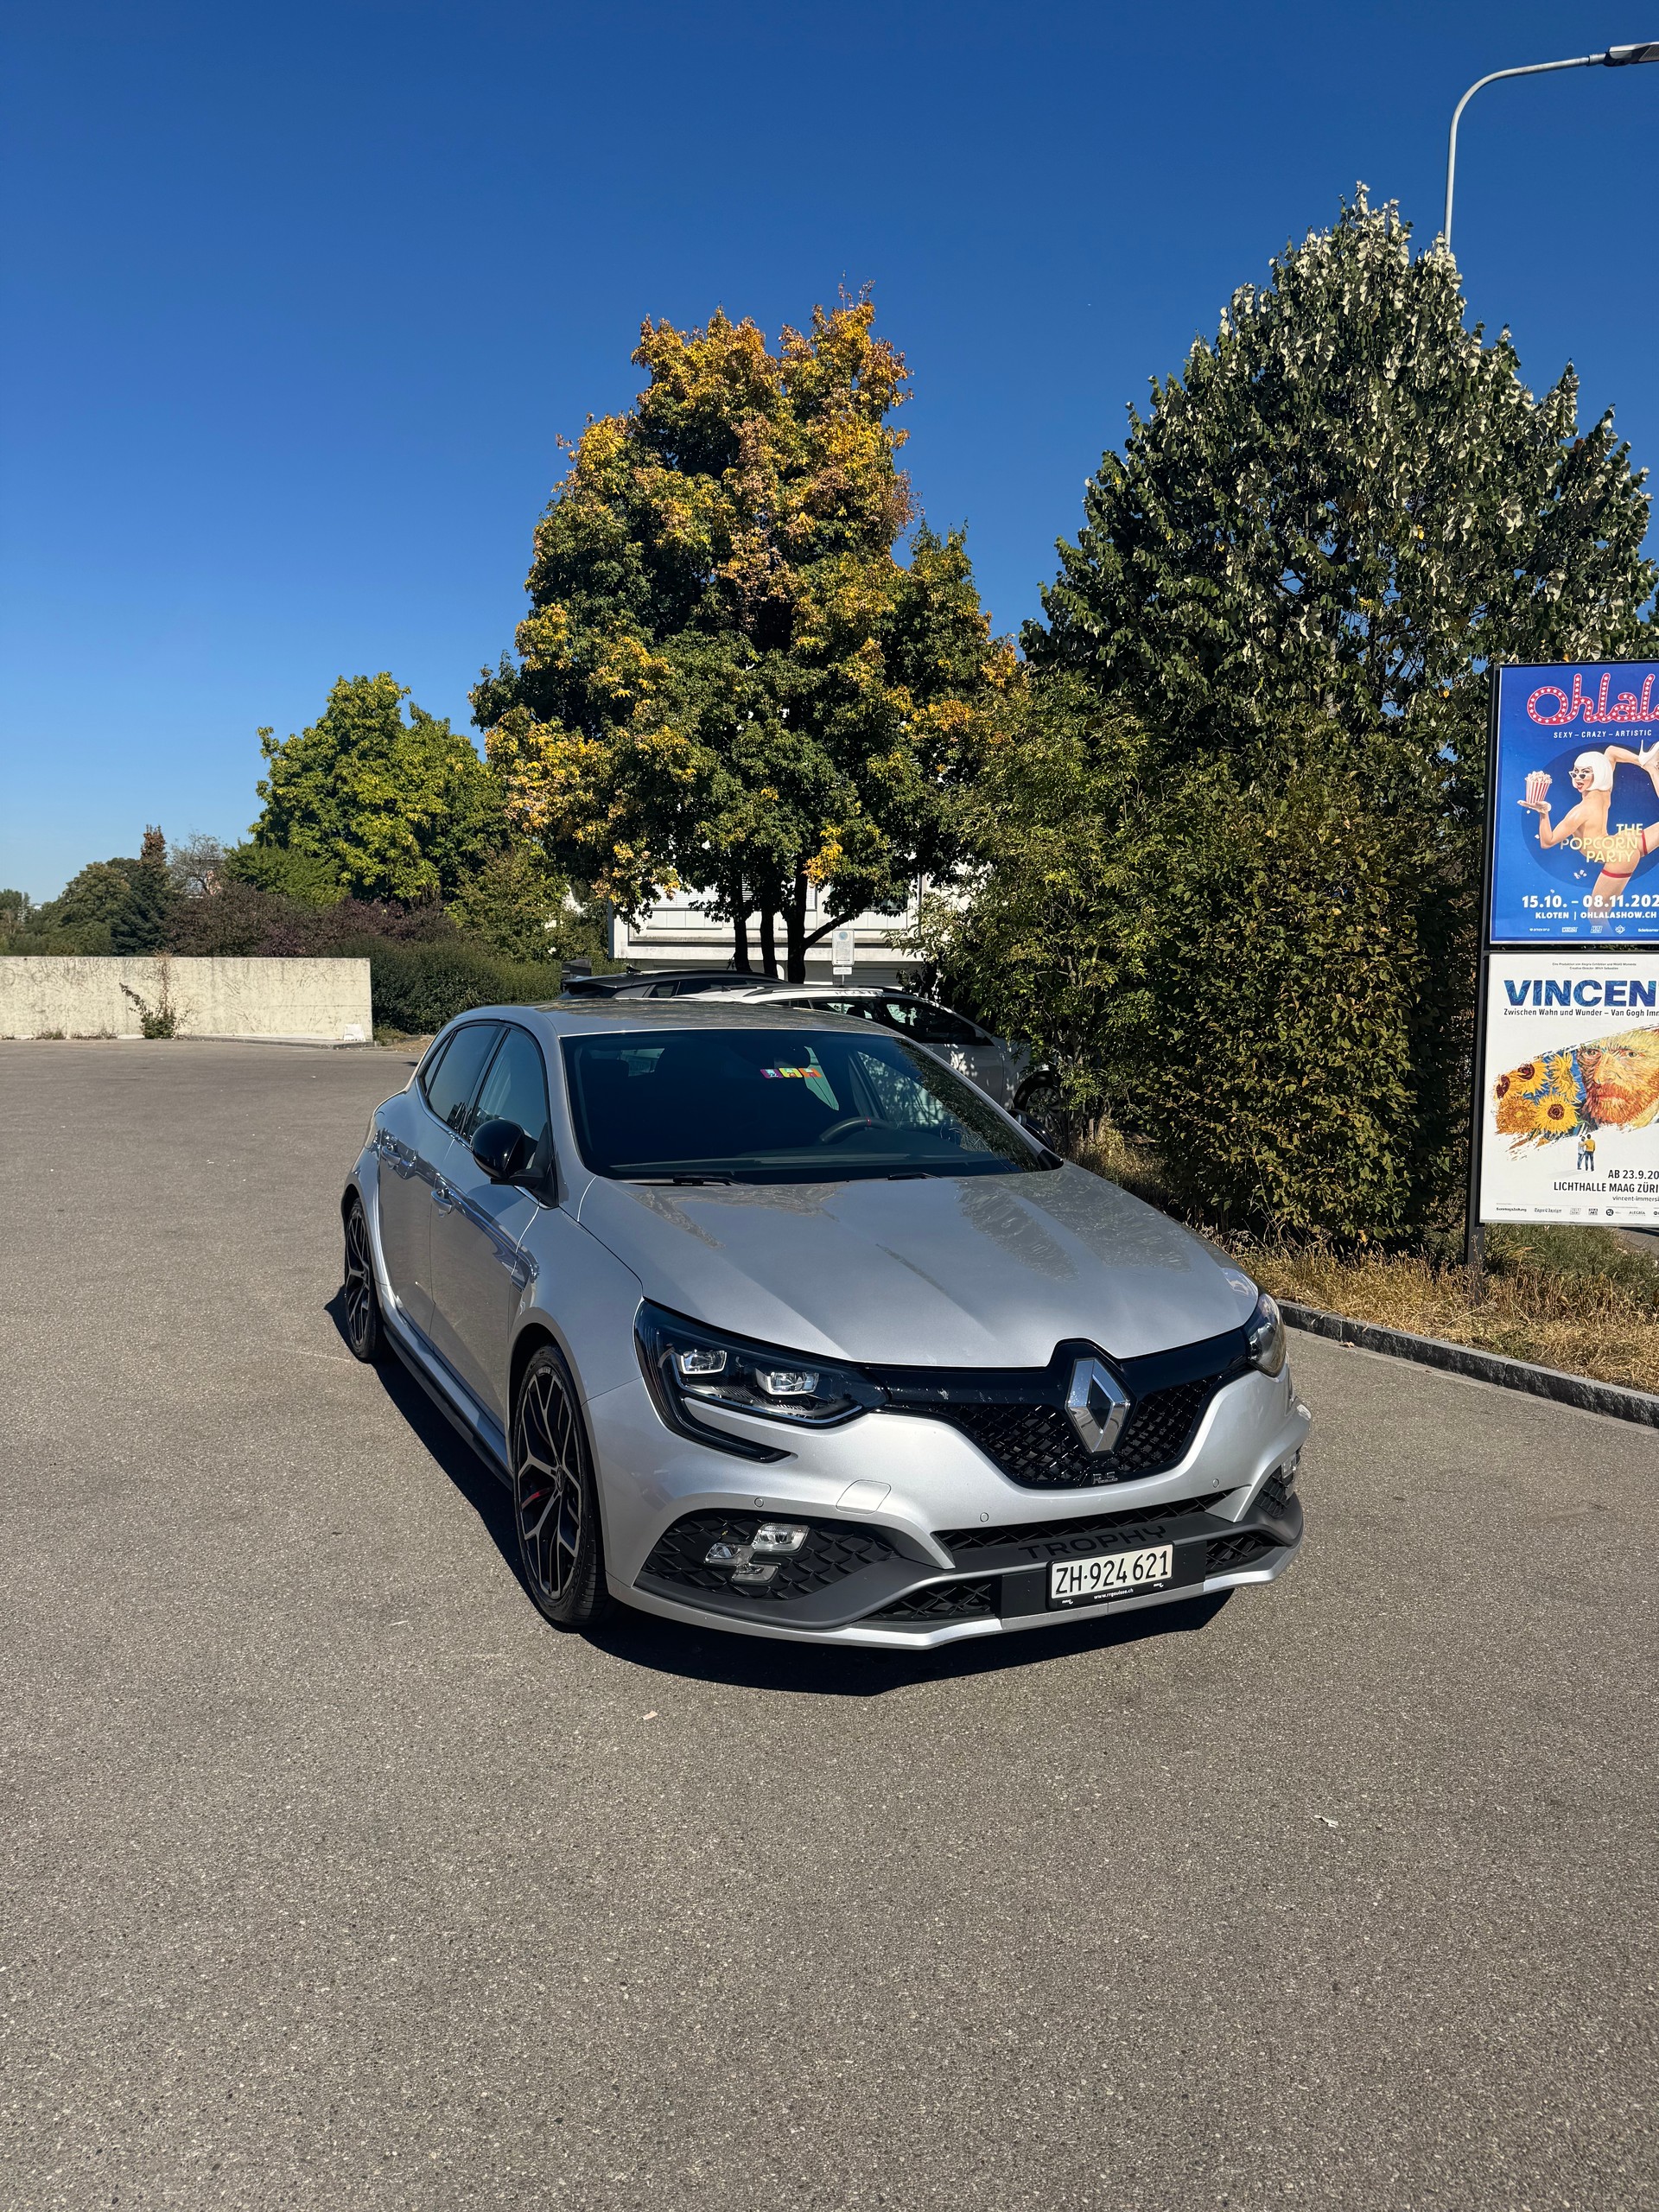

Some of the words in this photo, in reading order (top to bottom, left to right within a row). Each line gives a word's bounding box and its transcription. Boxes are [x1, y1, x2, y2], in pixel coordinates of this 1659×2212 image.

[1616, 823, 1643, 836] THE
[1560, 836, 1638, 850] POPCORN
[1586, 849, 1635, 863] PARTY
[1522, 895, 1567, 908] 15.10.
[1582, 894, 1659, 907] 08.11.202
[1503, 979, 1659, 1007] VINCEN
[1503, 1007, 1537, 1016] Zwischen
[1626, 1008, 1645, 1018] Gogh
[1607, 1169, 1620, 1179] AB
[1622, 1169, 1659, 1180] 23.9.20
[1554, 1181, 1607, 1192] LICHTHALLE
[1609, 1183, 1635, 1192] MAAG
[1637, 1181, 1659, 1193] ZÜRI
[1018, 1525, 1166, 1559] TROPHY
